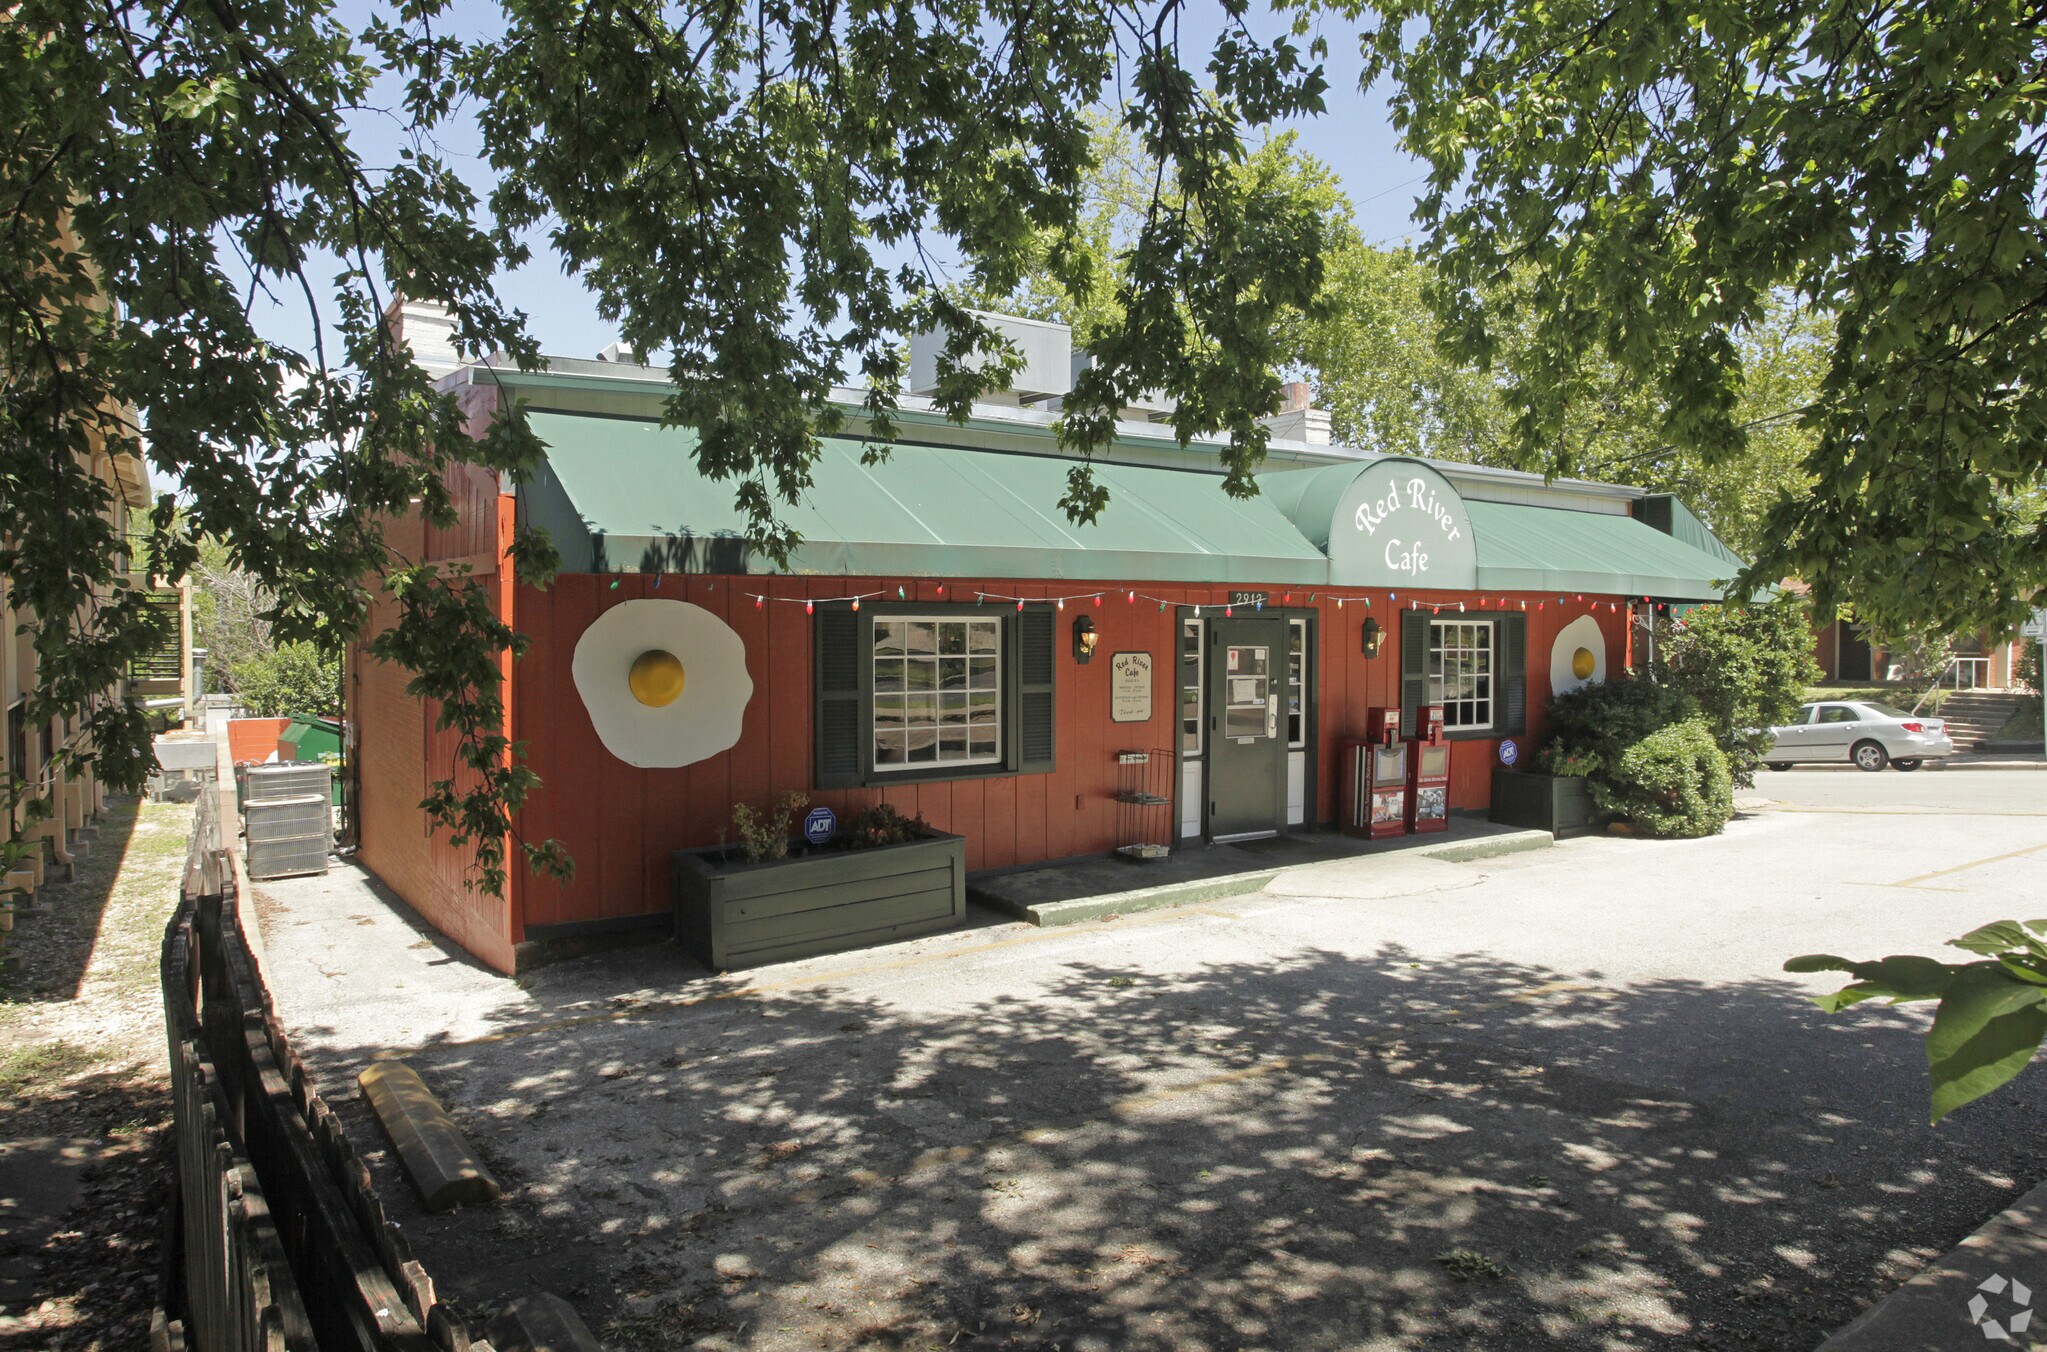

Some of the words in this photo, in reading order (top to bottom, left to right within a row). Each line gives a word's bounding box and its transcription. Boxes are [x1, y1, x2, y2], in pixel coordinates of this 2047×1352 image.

[1355, 479, 1401, 537] Red
[1406, 478, 1461, 541] River
[1385, 538, 1429, 577] Cafe
[1116, 657, 1129, 671] Red
[1125, 668, 1139, 678] Cafe
[810, 820, 830, 833] ADT
